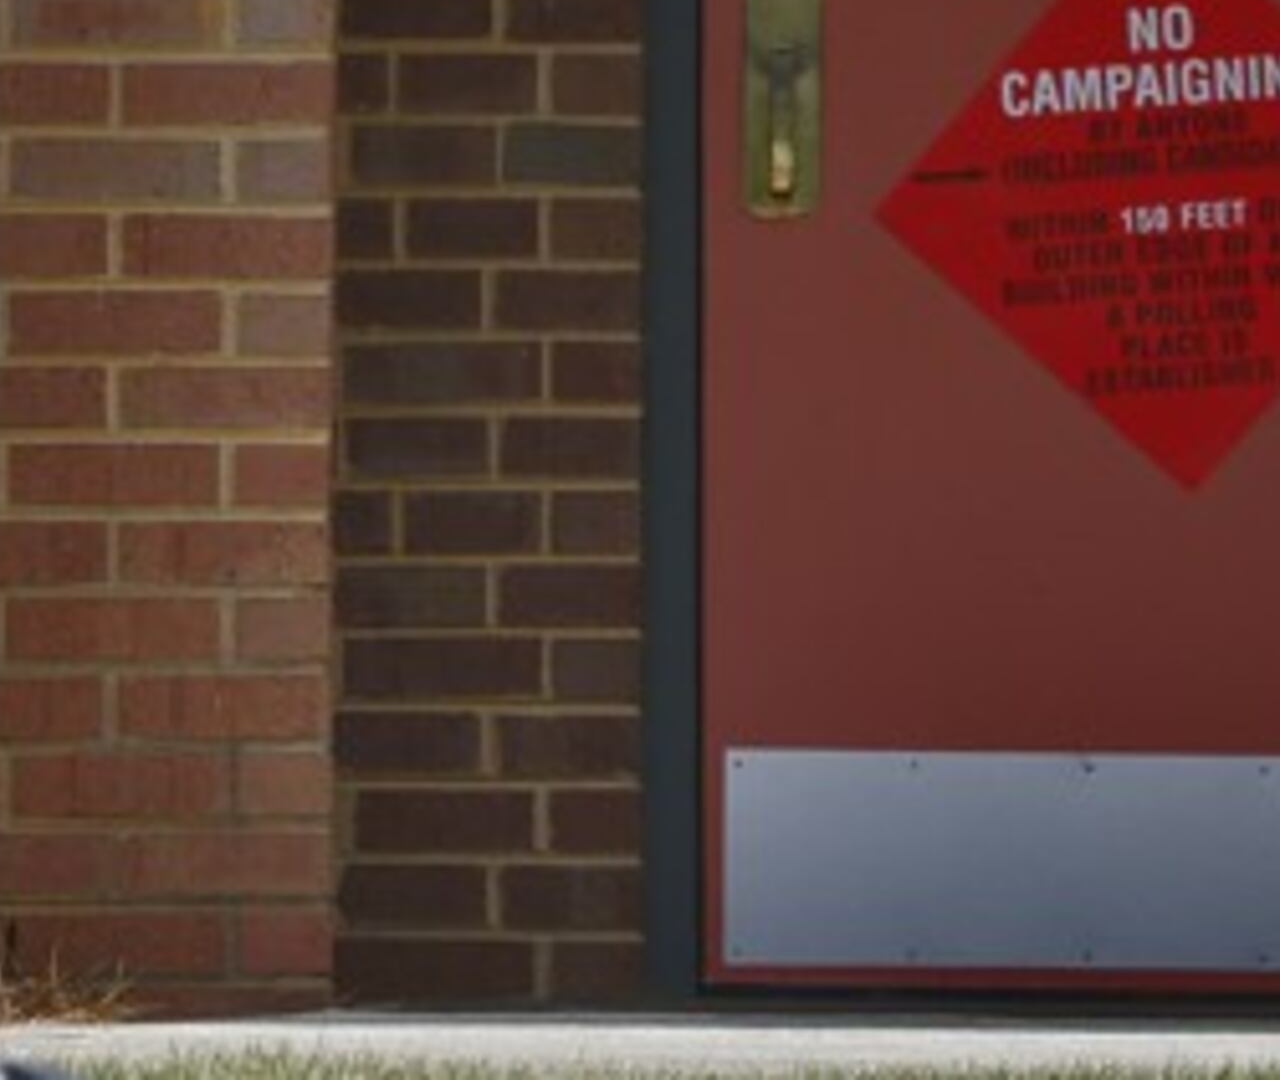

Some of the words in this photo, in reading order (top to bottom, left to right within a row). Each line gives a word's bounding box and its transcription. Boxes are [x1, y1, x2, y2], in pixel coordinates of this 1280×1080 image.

[1126, 3, 1194, 53] NO
[1135, 109, 1250, 139] ANYONE
[1007, 209, 1108, 240] WITHIN
[1120, 205, 1169, 234] 150
[1181, 198, 1249, 229] FEET
[1033, 239, 1124, 272] OUTER
[1003, 272, 1138, 306] BUILDING
[1149, 263, 1253, 293] WITHIN
[1135, 296, 1259, 324] POLLING
[1121, 329, 1208, 357] PLACE
